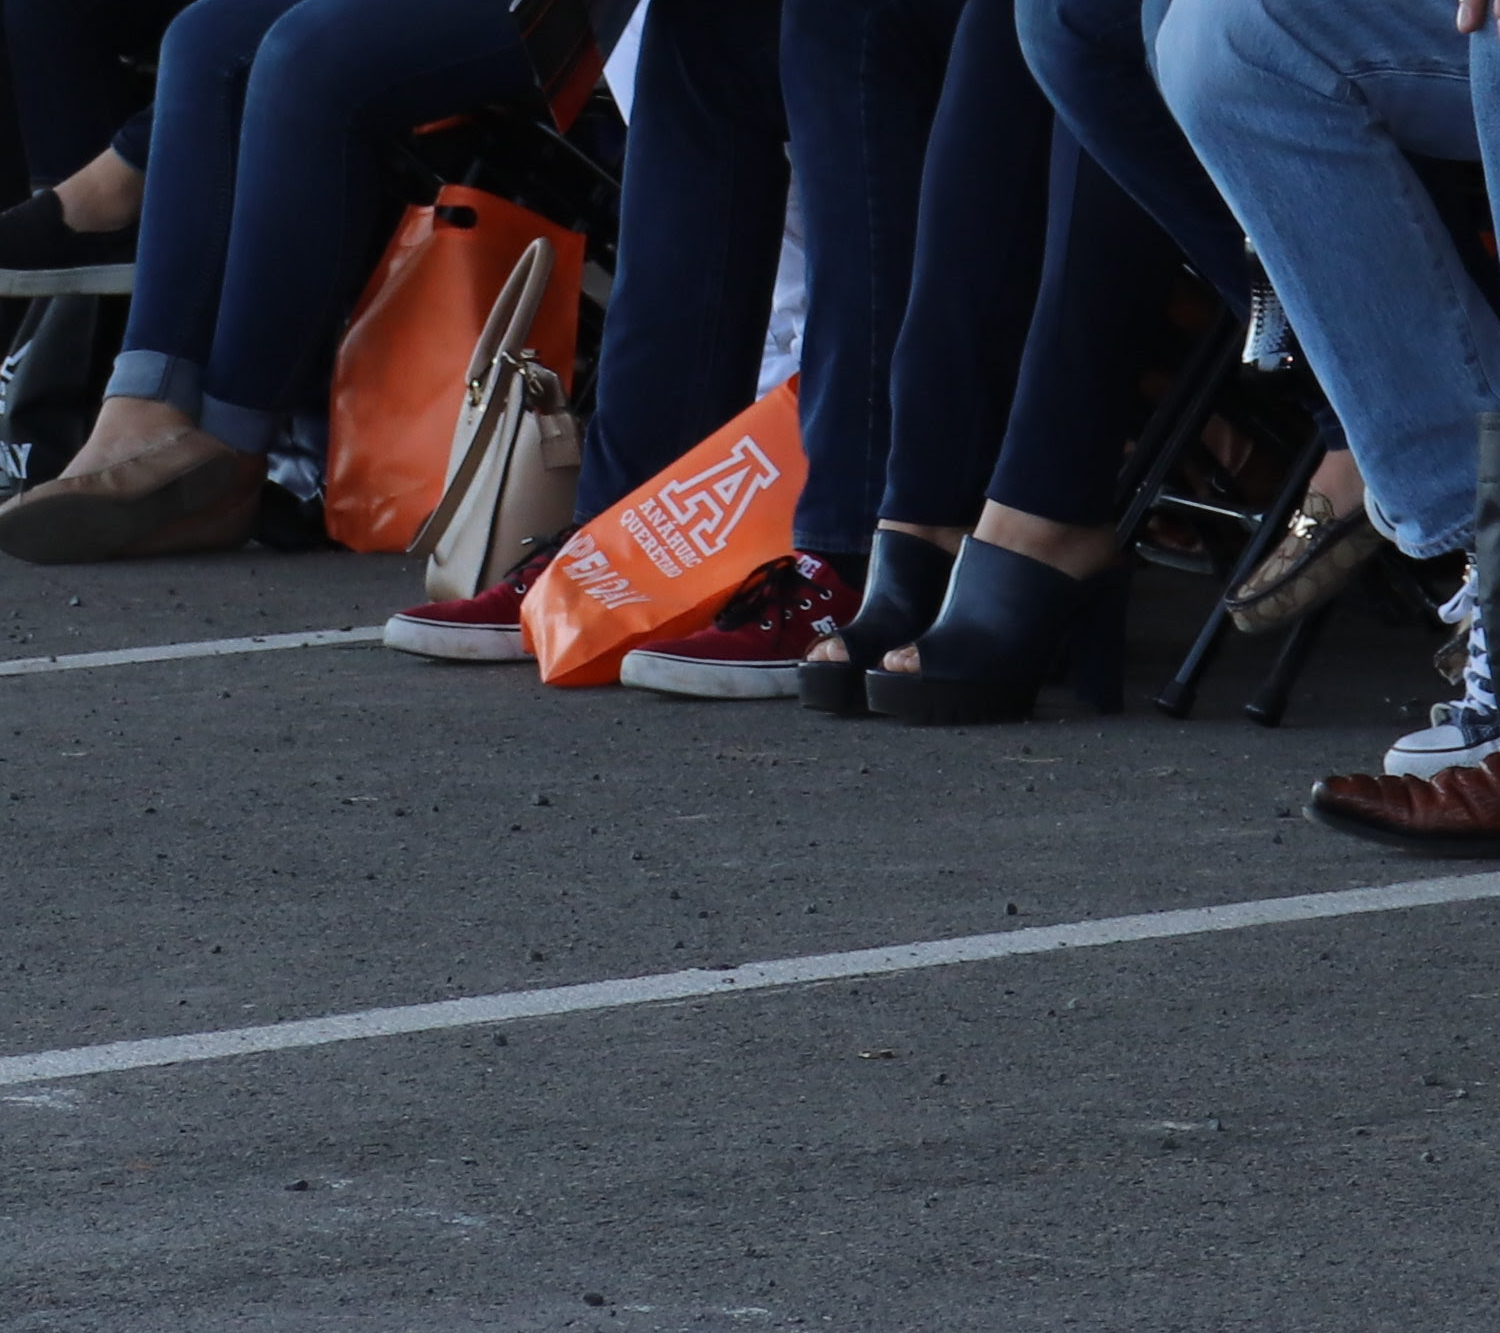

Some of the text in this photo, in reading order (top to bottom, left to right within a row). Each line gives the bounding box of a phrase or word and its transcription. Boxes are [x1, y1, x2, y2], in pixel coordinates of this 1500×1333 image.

[658, 435, 781, 557] A
[553, 531, 619, 587] PEN
[638, 497, 703, 569] ANÁHUAC
